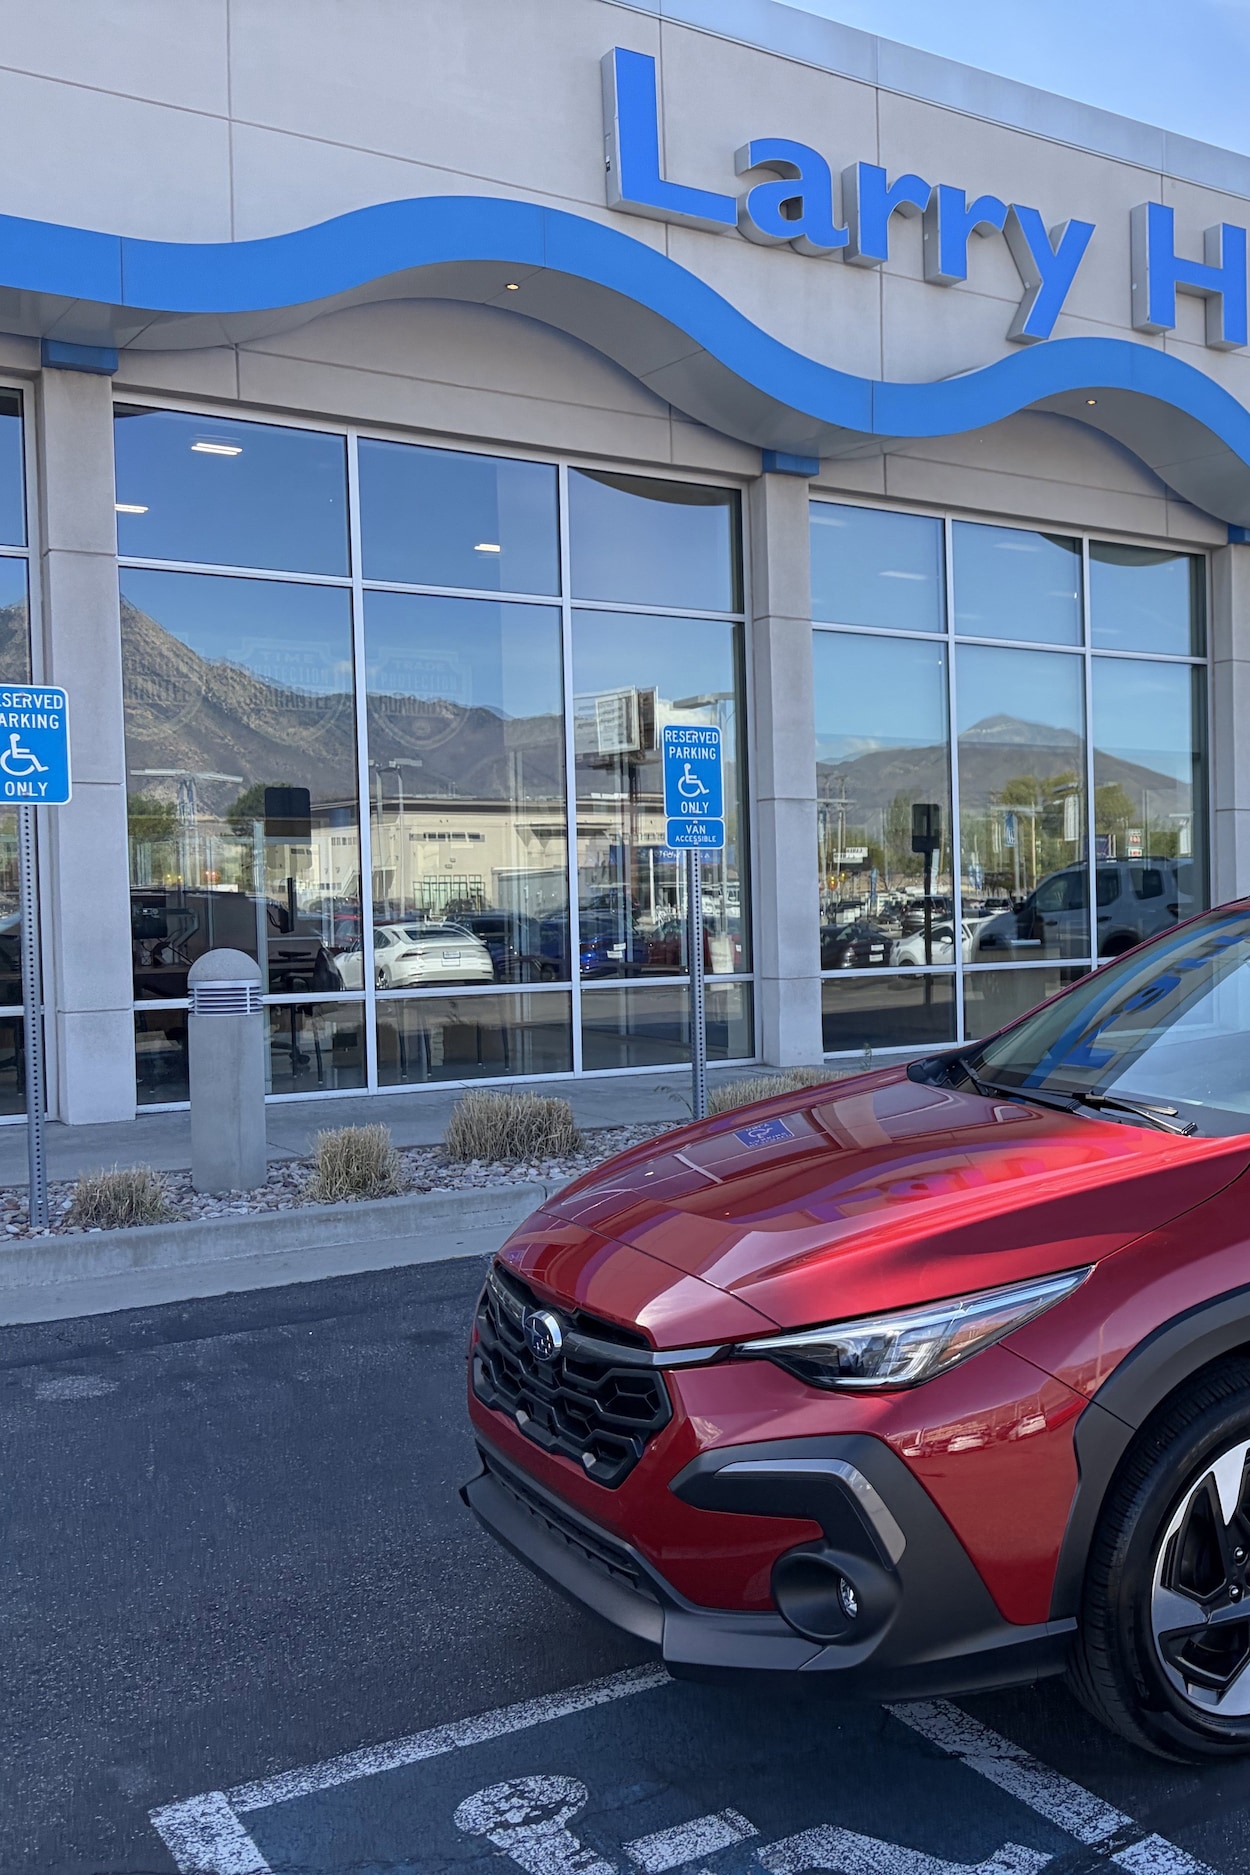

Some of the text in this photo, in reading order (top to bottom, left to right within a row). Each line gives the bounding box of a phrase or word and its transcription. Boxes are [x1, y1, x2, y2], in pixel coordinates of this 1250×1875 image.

[604, 46, 1096, 345] Larry
[1131, 200, 1247, 352] H
[0, 692, 64, 710] SERVED
[0, 712, 60, 730] ARKING
[665, 730, 719, 744] RESERVED
[669, 746, 717, 760] PARKING
[4, 780, 49, 797] ONLY
[680, 801, 710, 814] ONLY
[686, 824, 706, 835] VAN
[675, 835, 717, 843] ACCESSIBLE
